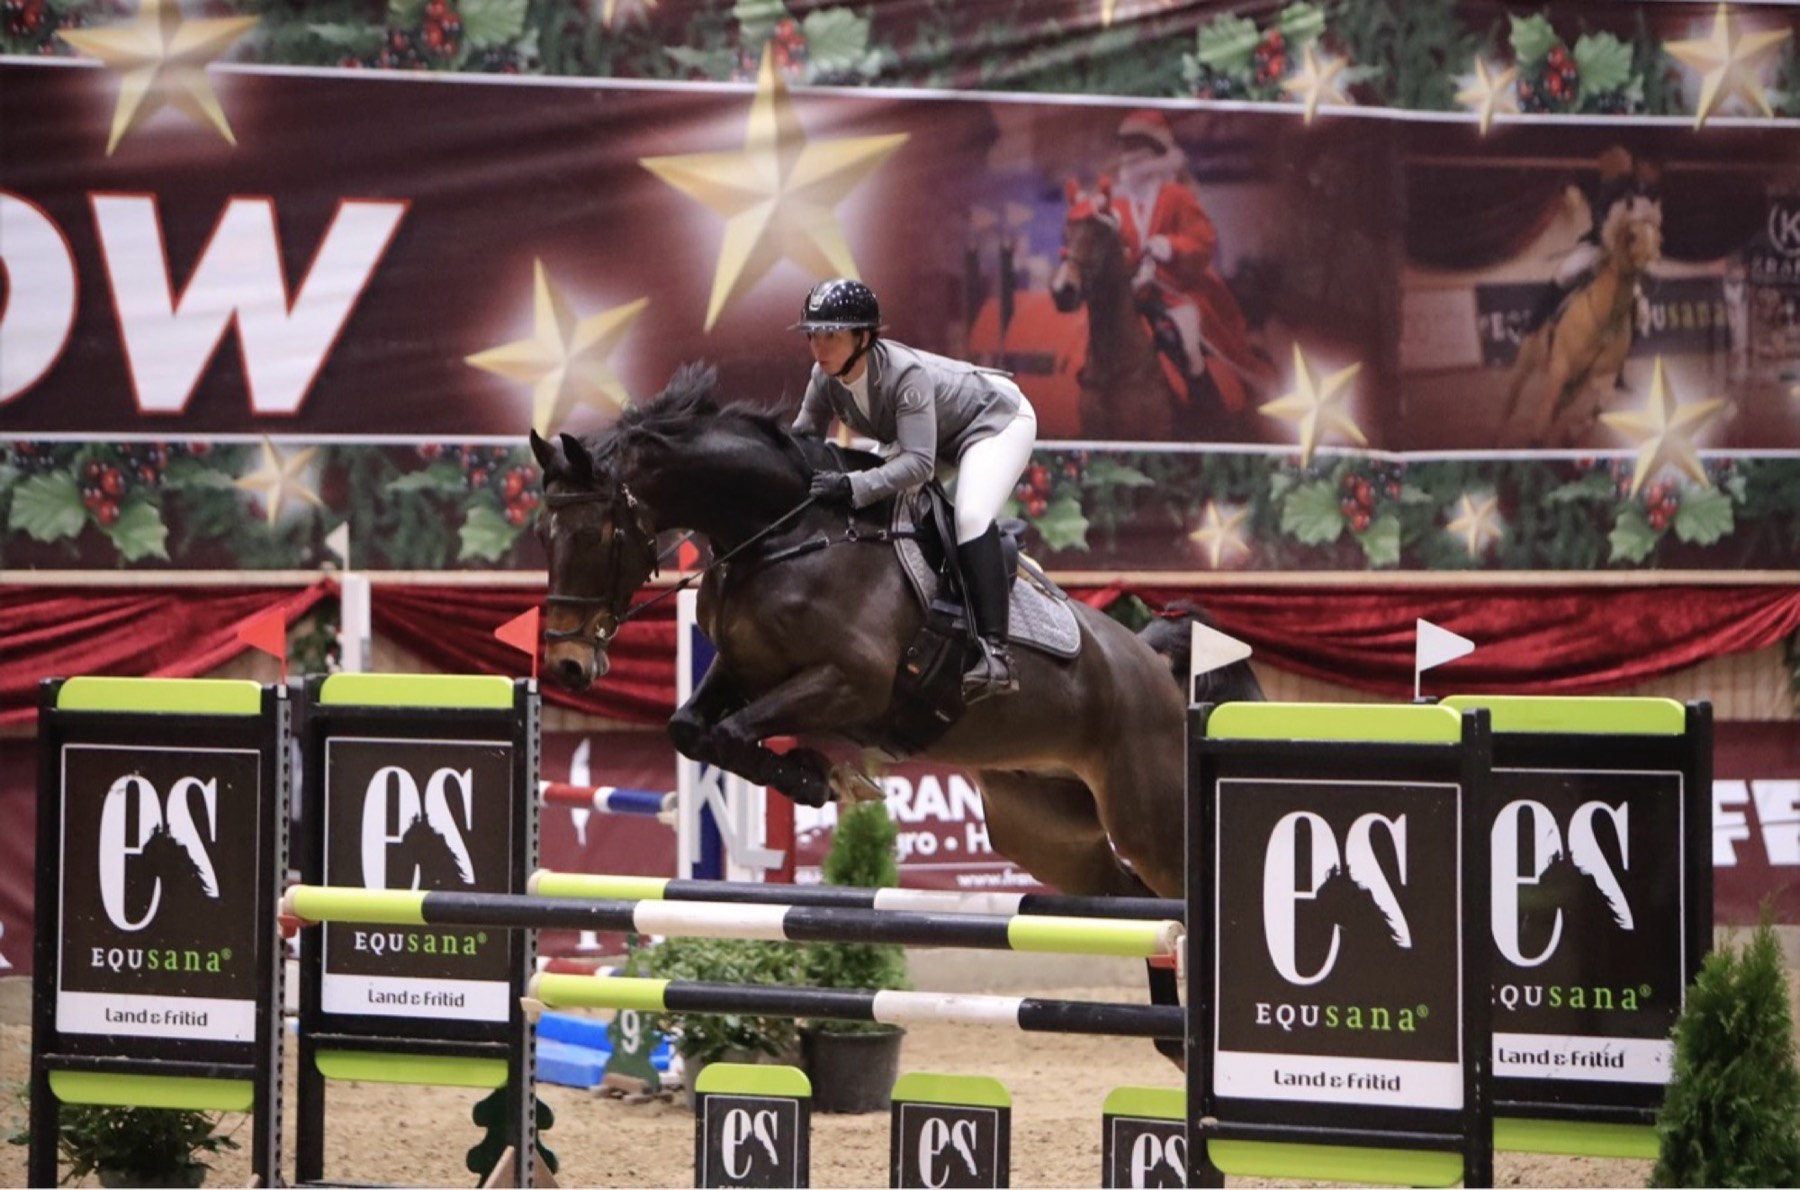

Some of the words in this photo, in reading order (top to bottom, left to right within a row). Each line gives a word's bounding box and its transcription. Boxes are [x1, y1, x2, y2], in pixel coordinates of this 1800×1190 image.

[873, 774, 986, 822] RAN
[368, 988, 408, 1005] Land
[105, 1007, 148, 1024] Land
[621, 1009, 640, 1054] 9
[1499, 1047, 1550, 1066] Land
[1274, 1069, 1326, 1088] Land
